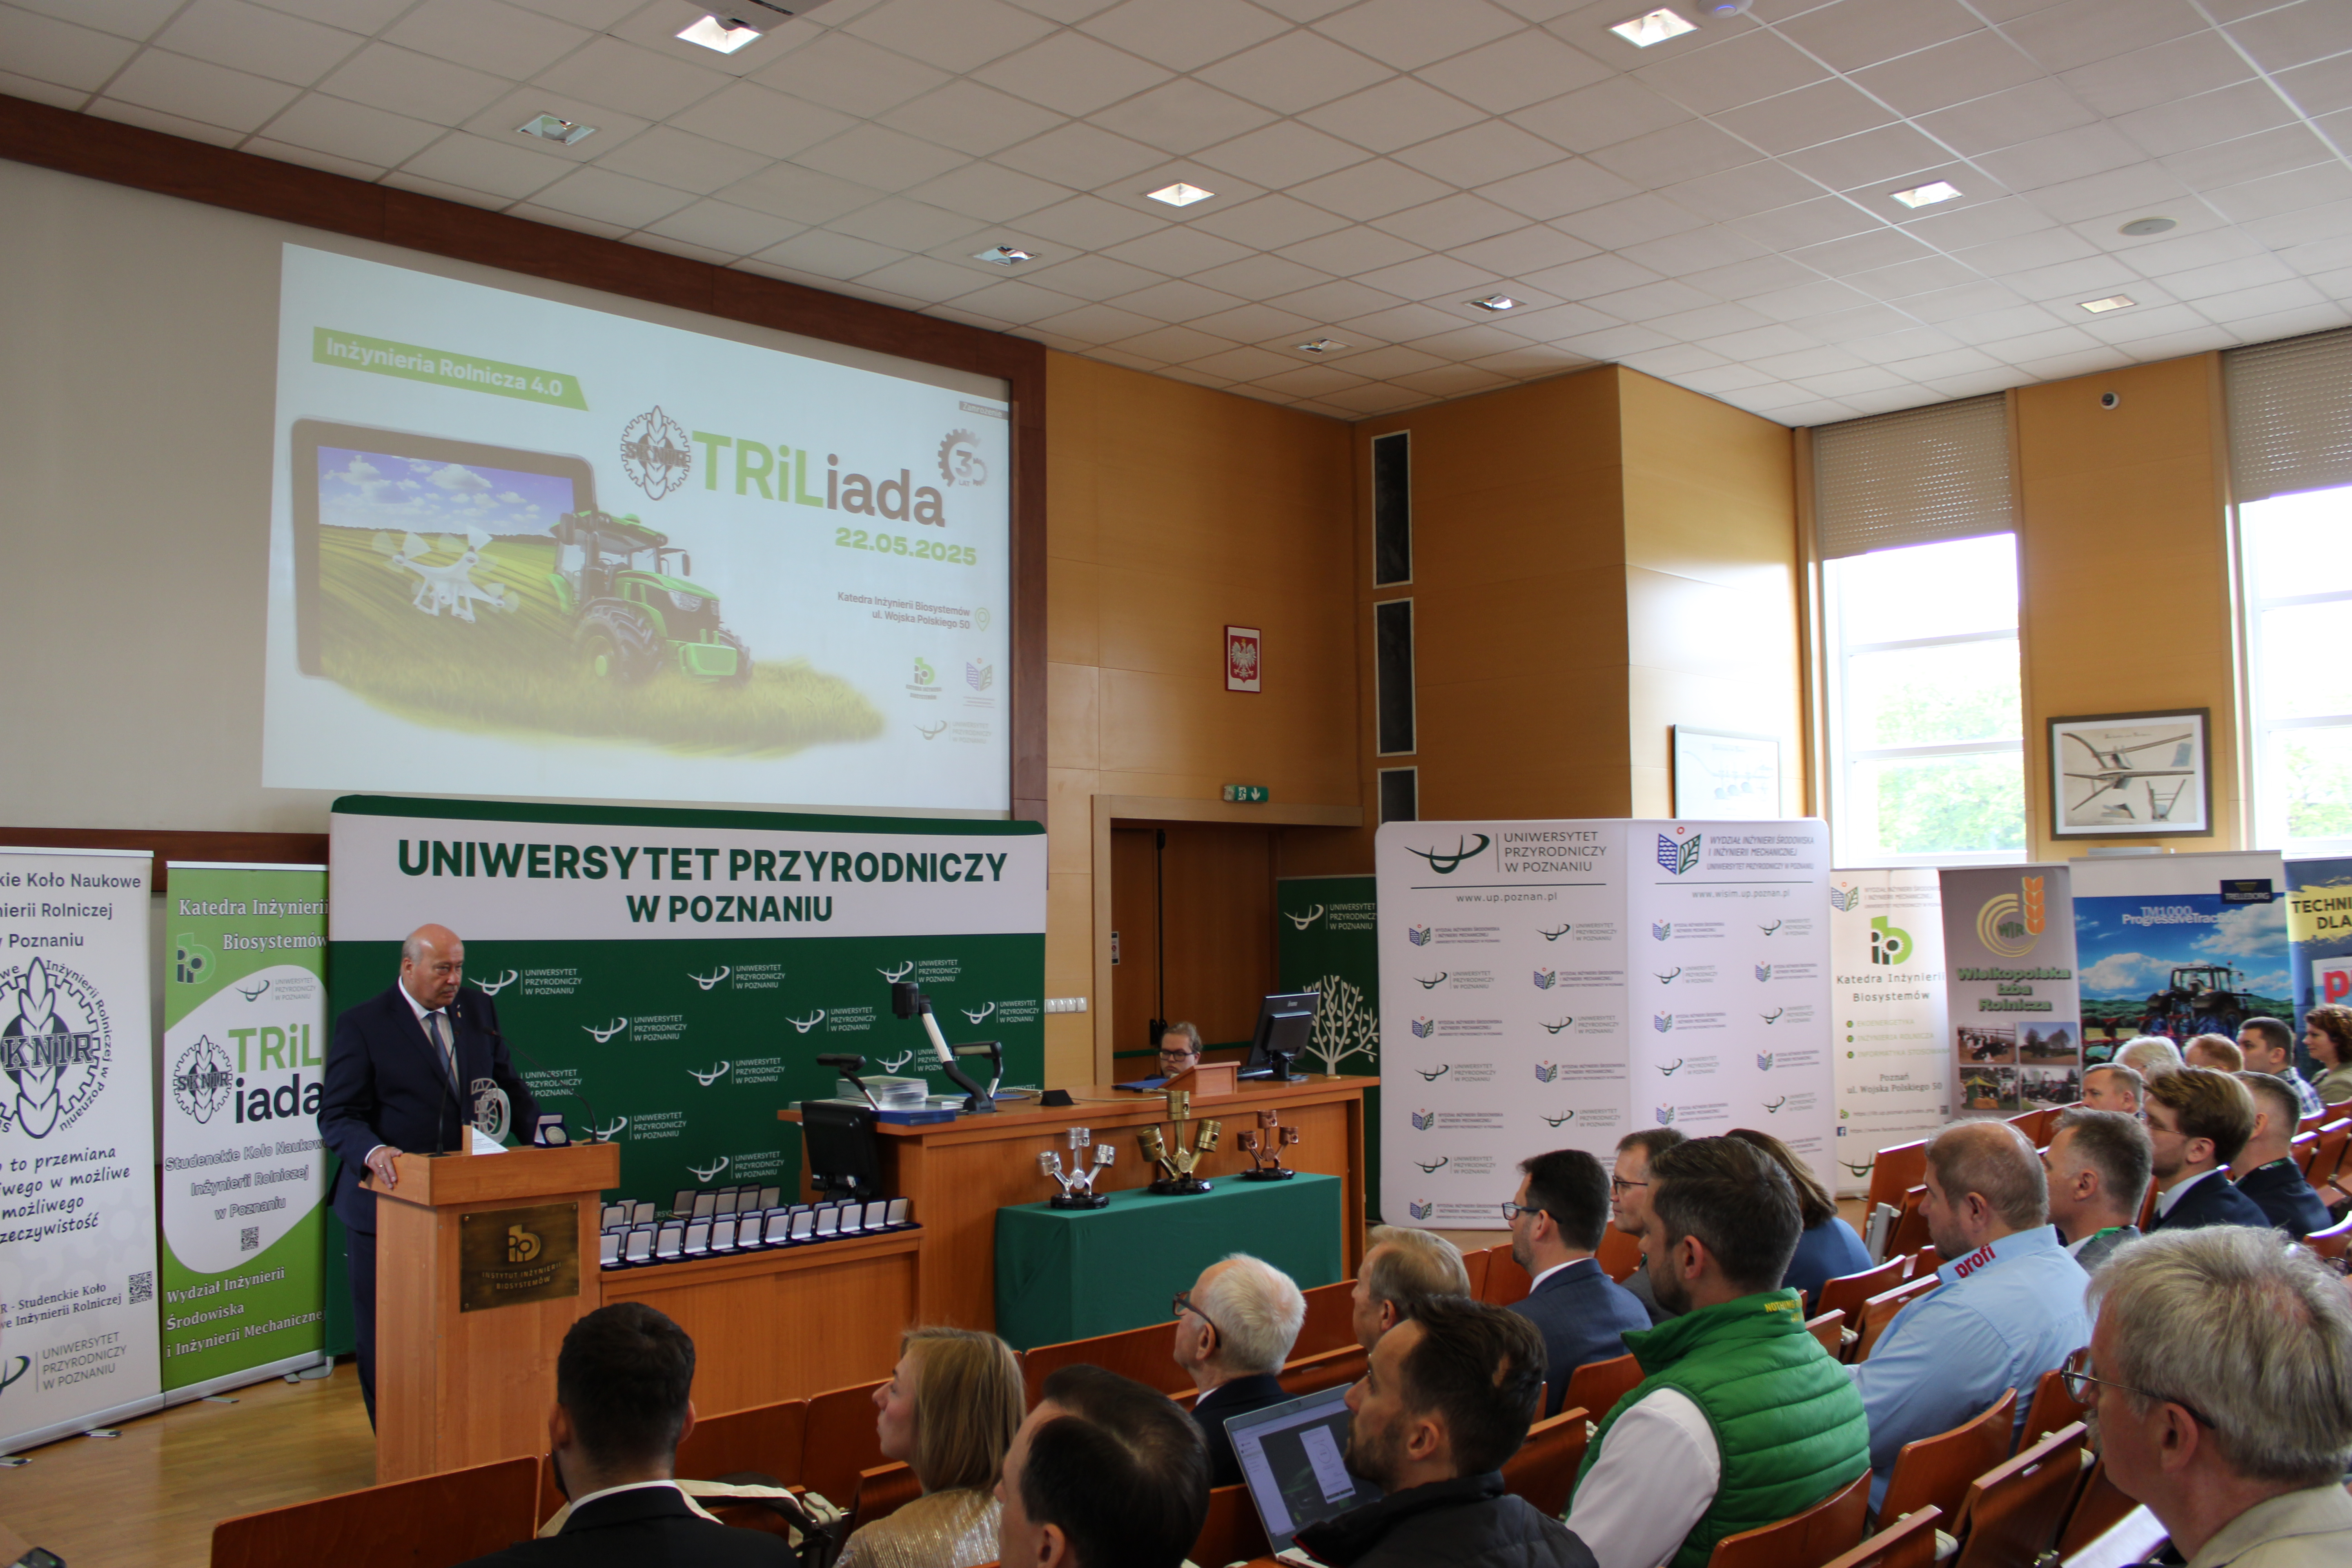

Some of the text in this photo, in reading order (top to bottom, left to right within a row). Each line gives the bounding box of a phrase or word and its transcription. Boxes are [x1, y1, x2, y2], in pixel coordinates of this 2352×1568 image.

[327, 336, 563, 397] Inżynieria Rolnicza 4.0
[692, 430, 946, 528] TRiLiada
[835, 527, 977, 566] 22.05.2025
[838, 591, 970, 617] Katedra Inżynierii Biosystemów
[872, 610, 970, 629] ul. Wojska Polskiego 50
[1504, 831, 1599, 843] UNIWERSYTET
[1710, 836, 1741, 844] WYDZIAŁ
[1505, 846, 1607, 858] PRZYRODNICZY
[398, 839, 1008, 883] UNIWERSYTET PRZYRODNICZY
[1505, 861, 1592, 873] W POZNANIU
[27, 871, 65, 887] Koło
[71, 873, 142, 888] Naukowe
[1456, 892, 1557, 903] www.up.poznan.pl
[2225, 892, 2270, 900] TRELLEBORG
[0, 902, 113, 920] ierii Rolniczej
[179, 897, 247, 916] Katedra
[626, 895, 833, 923] W POZNANIU
[2140, 906, 2192, 916] TM1000
[2122, 912, 2240, 927] ProgressiveTraction
[2316, 915, 2352, 930] DLA
[1998, 921, 2025, 939] WIR
[9, 932, 84, 948] Poznaniu
[223, 931, 328, 953] Biosystemów
[45, 960, 100, 999] Inżynierii
[524, 968, 578, 976] UNIWERSYTET
[1837, 972, 1946, 984] Katedra Inżynierii
[1957, 966, 2072, 983] Wielkopolska
[525, 977, 583, 986] PRZYRODNICZY
[1853, 990, 1930, 1003] Biosystemów
[1979, 998, 2053, 1011] Rolnicza
[633, 1014, 683, 1024] UNIWERSYTET
[830, 1007, 873, 1015] UNIWERSYTET
[830, 1015, 877, 1023] PRZYRODNICZY
[95, 999, 113, 1063] Rolniczej
[633, 1024, 688, 1033] PRZYRODNICZY
[643, 1033, 680, 1041] POZNANIU
[227, 1023, 322, 1073] TRiL
[736, 1058, 781, 1067] UNIWERSYTET
[736, 1066, 785, 1075] PRZYRODNICZY
[177, 1071, 230, 1092] SKNIR
[1879, 1073, 1909, 1082] Poznań
[1860, 1085, 1889, 1094] Wojska
[1891, 1083, 1930, 1093] Polskiego
[59, 1081, 105, 1132] Poznaniu
[236, 1073, 325, 1124] iada
[633, 1112, 682, 1122] UNIWERSYTET
[633, 1120, 687, 1131] PRZYRODNICZY
[642, 1130, 679, 1139] POZNANIU
[10, 1147, 116, 1174] to przemiana
[165, 1148, 241, 1171] Studenckie
[243, 1143, 273, 1160] Koło
[735, 1151, 780, 1161] UNIWERSYTET
[735, 1160, 785, 1170] PRZYRODNICZY
[743, 1169, 777, 1178] POZNANIU
[51, 1177, 63, 1189] w
[70, 1166, 131, 1186] możliwe
[191, 1164, 309, 1196] Inżynierii Rolniczej
[2, 1197, 84, 1220] możliwego
[214, 1196, 287, 1220] w Poznaniu
[0, 1211, 100, 1245] zeczywistość
[1954, 1243, 1996, 1278] profi
[520, 1261, 562, 1278] INŻYNIERII
[166, 1266, 285, 1304] Wydział Inżynierii
[496, 1276, 550, 1290] BIOSYSTEMÓW
[18, 1289, 79, 1310] Studenckie
[82, 1283, 106, 1296] Koło
[16, 1305, 70, 1327] Inżynierii
[73, 1293, 122, 1314] Rolniczej
[166, 1303, 245, 1331] Środowiska
[165, 1306, 326, 1358] i Inżynierii Mechanicznej
[42, 1331, 120, 1360] UNIWERSYTET
[43, 1345, 127, 1375] PRZYRODNICZY
[43, 1362, 116, 1391] W POZNANIU
